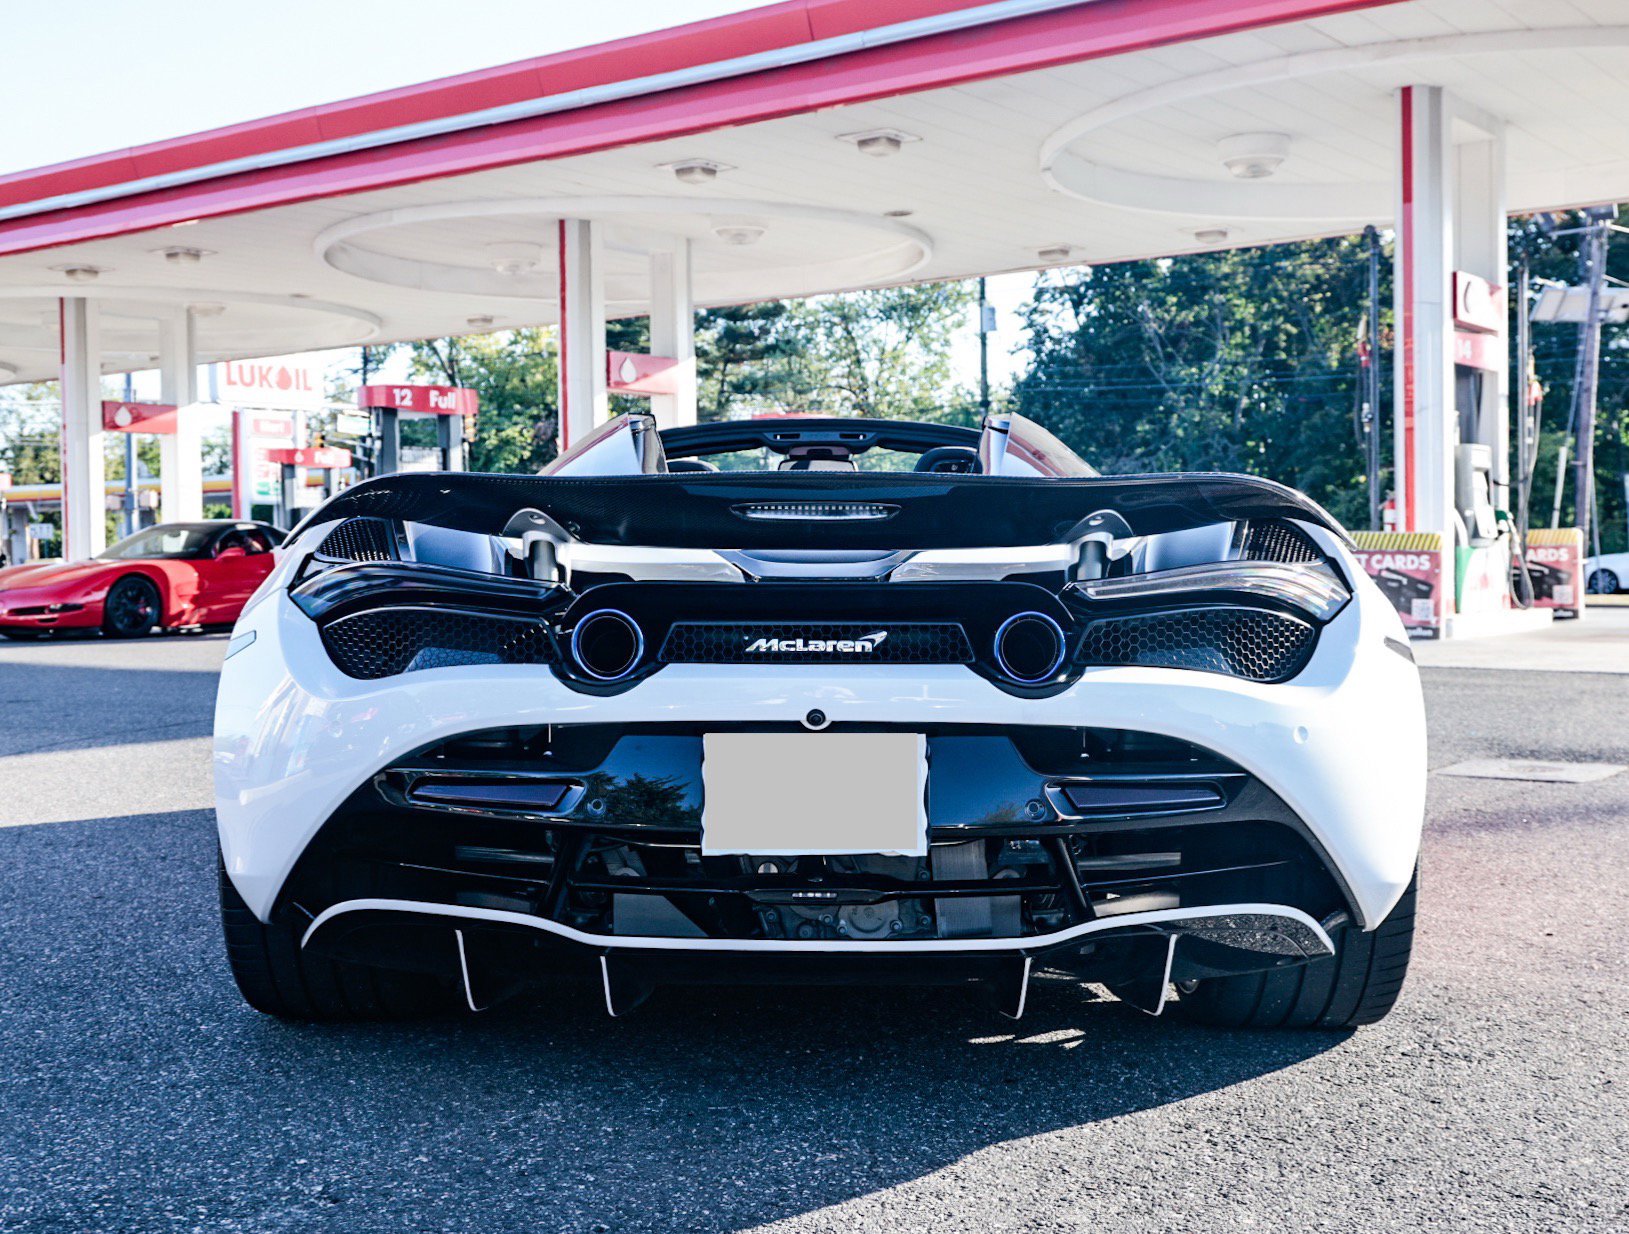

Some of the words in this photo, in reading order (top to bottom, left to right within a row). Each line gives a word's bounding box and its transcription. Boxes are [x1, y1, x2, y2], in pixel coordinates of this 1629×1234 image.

[225, 360, 313, 391] LUKOIL
[393, 388, 413, 407] 12
[429, 389, 457, 410] Full
[1370, 554, 1431, 571] CARDS
[1525, 547, 1569, 562] ARDS
[745, 638, 873, 652] McLaren
